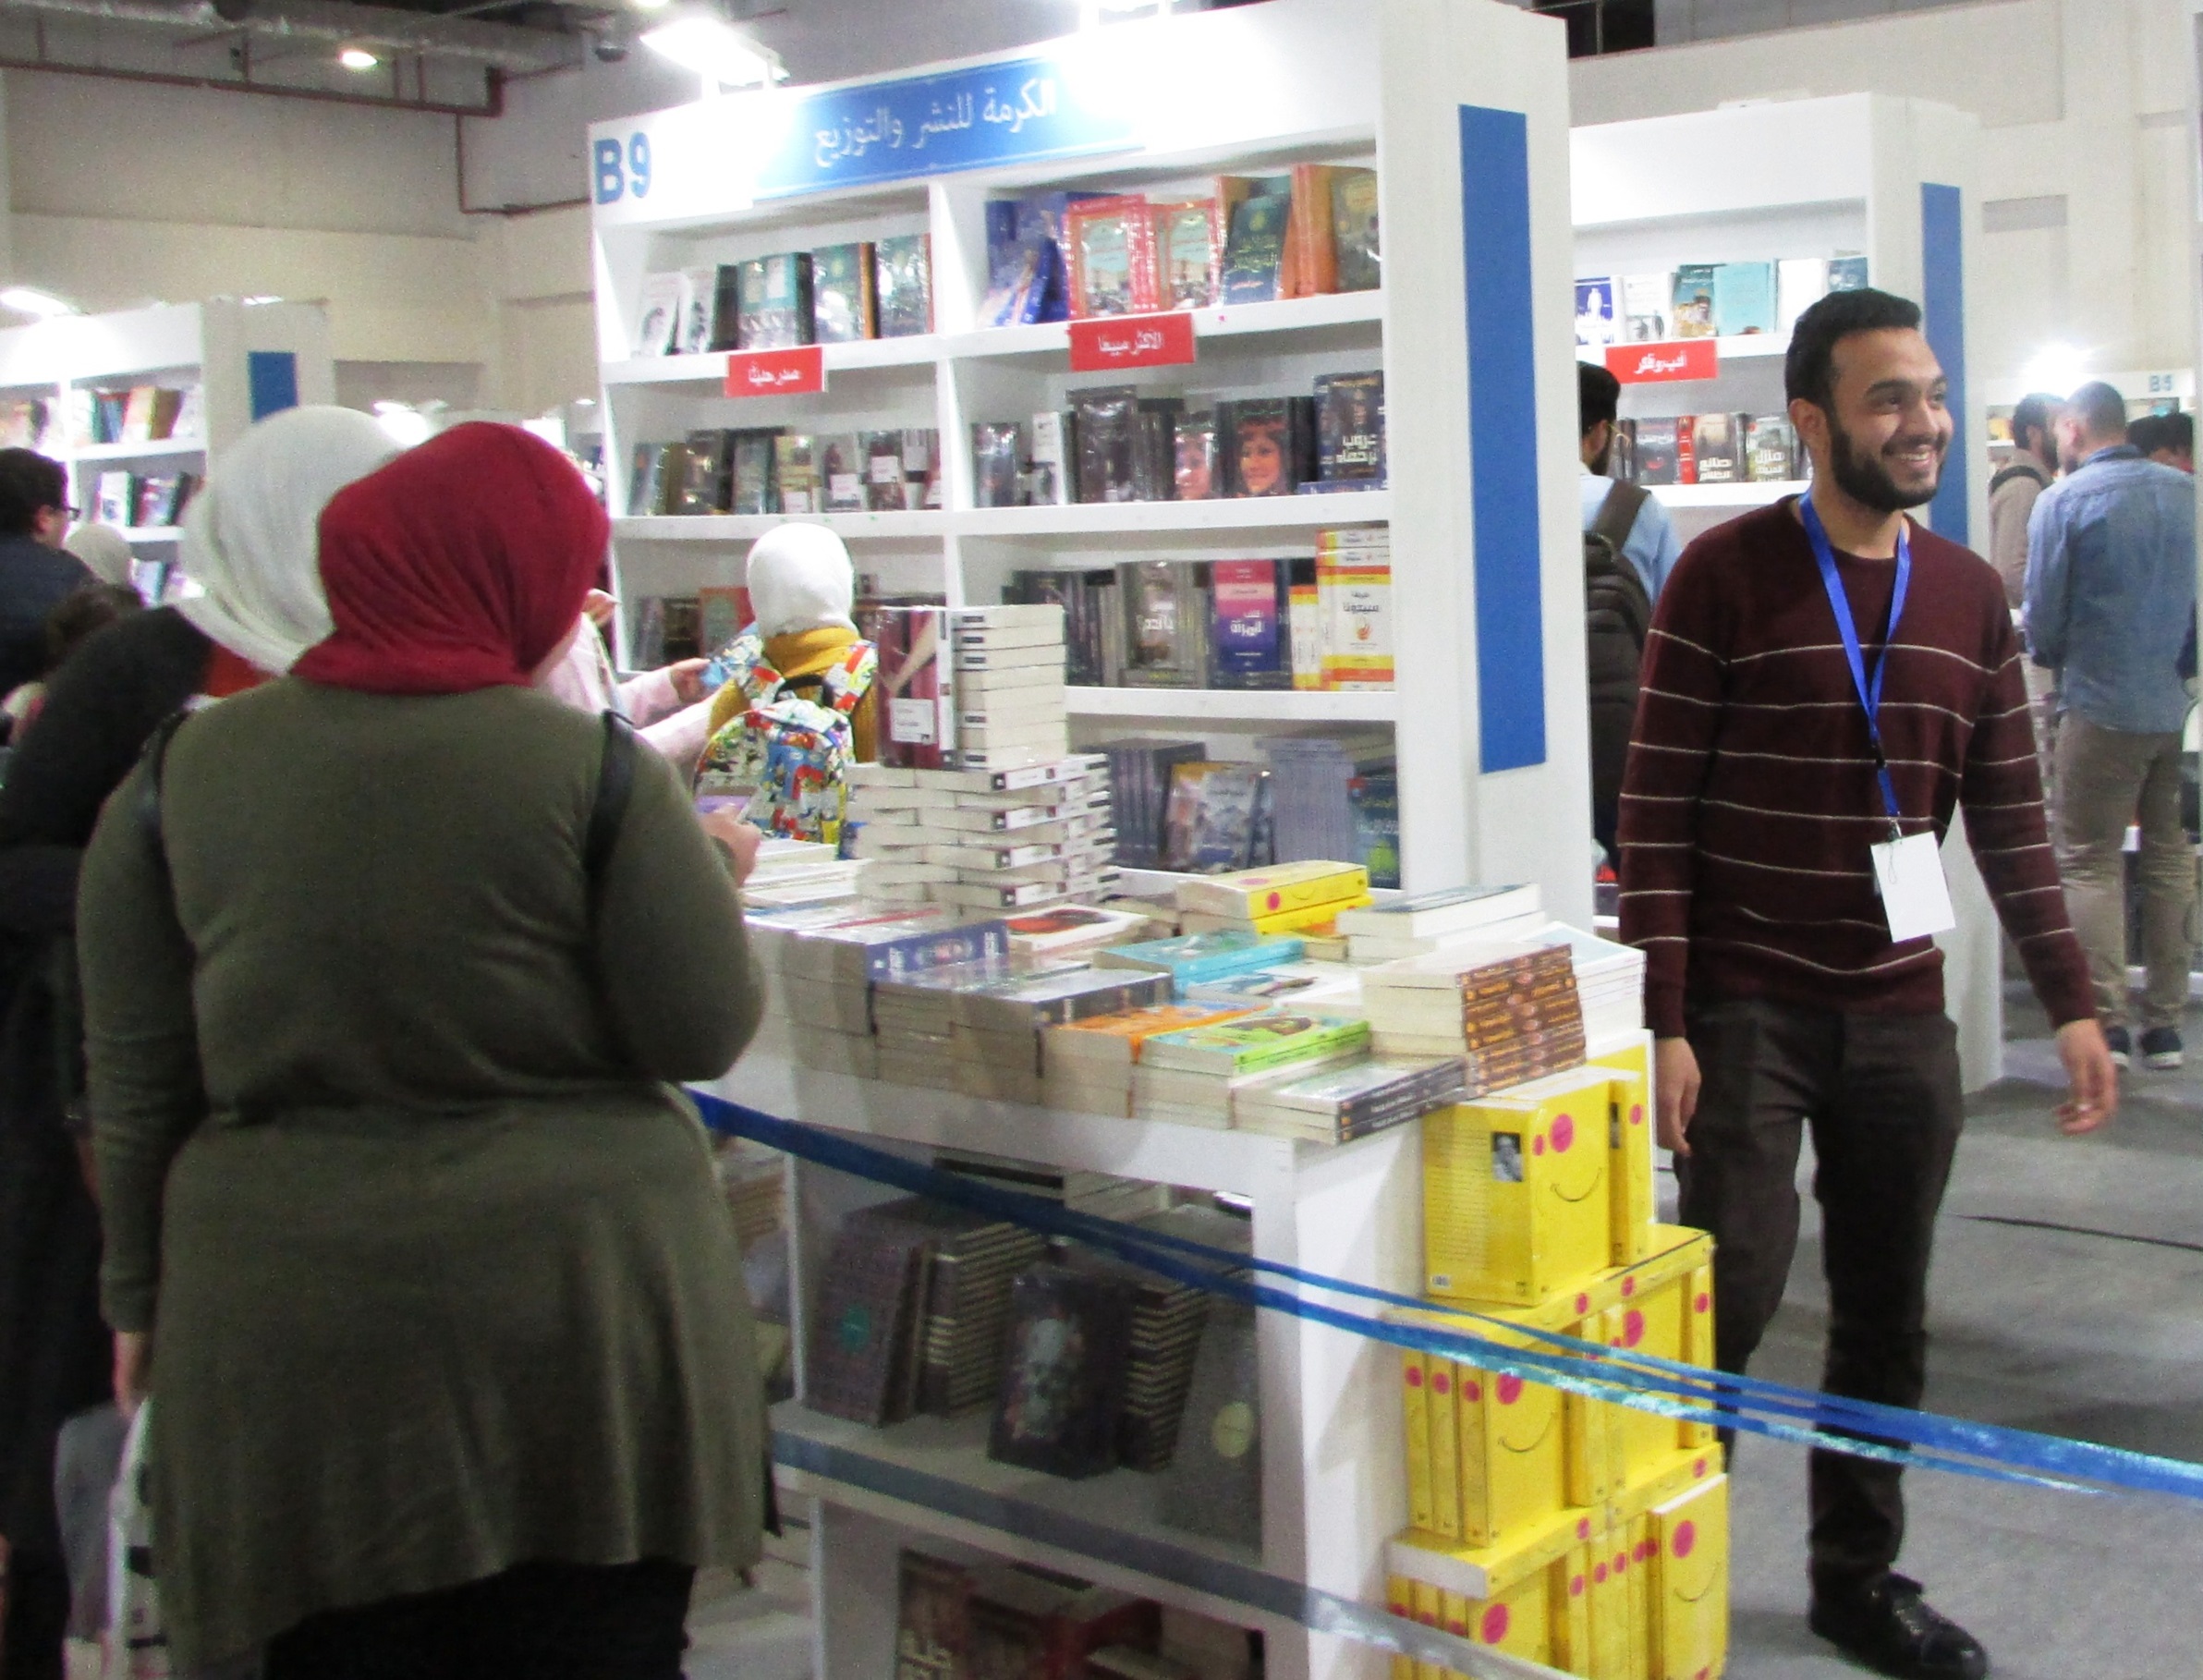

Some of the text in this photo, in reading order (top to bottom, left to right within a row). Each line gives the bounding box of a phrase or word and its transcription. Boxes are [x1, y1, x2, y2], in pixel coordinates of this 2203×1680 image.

[813, 78, 1057, 168] الكرمة للنشر والتوزيع
[593, 131, 651, 205] B9
